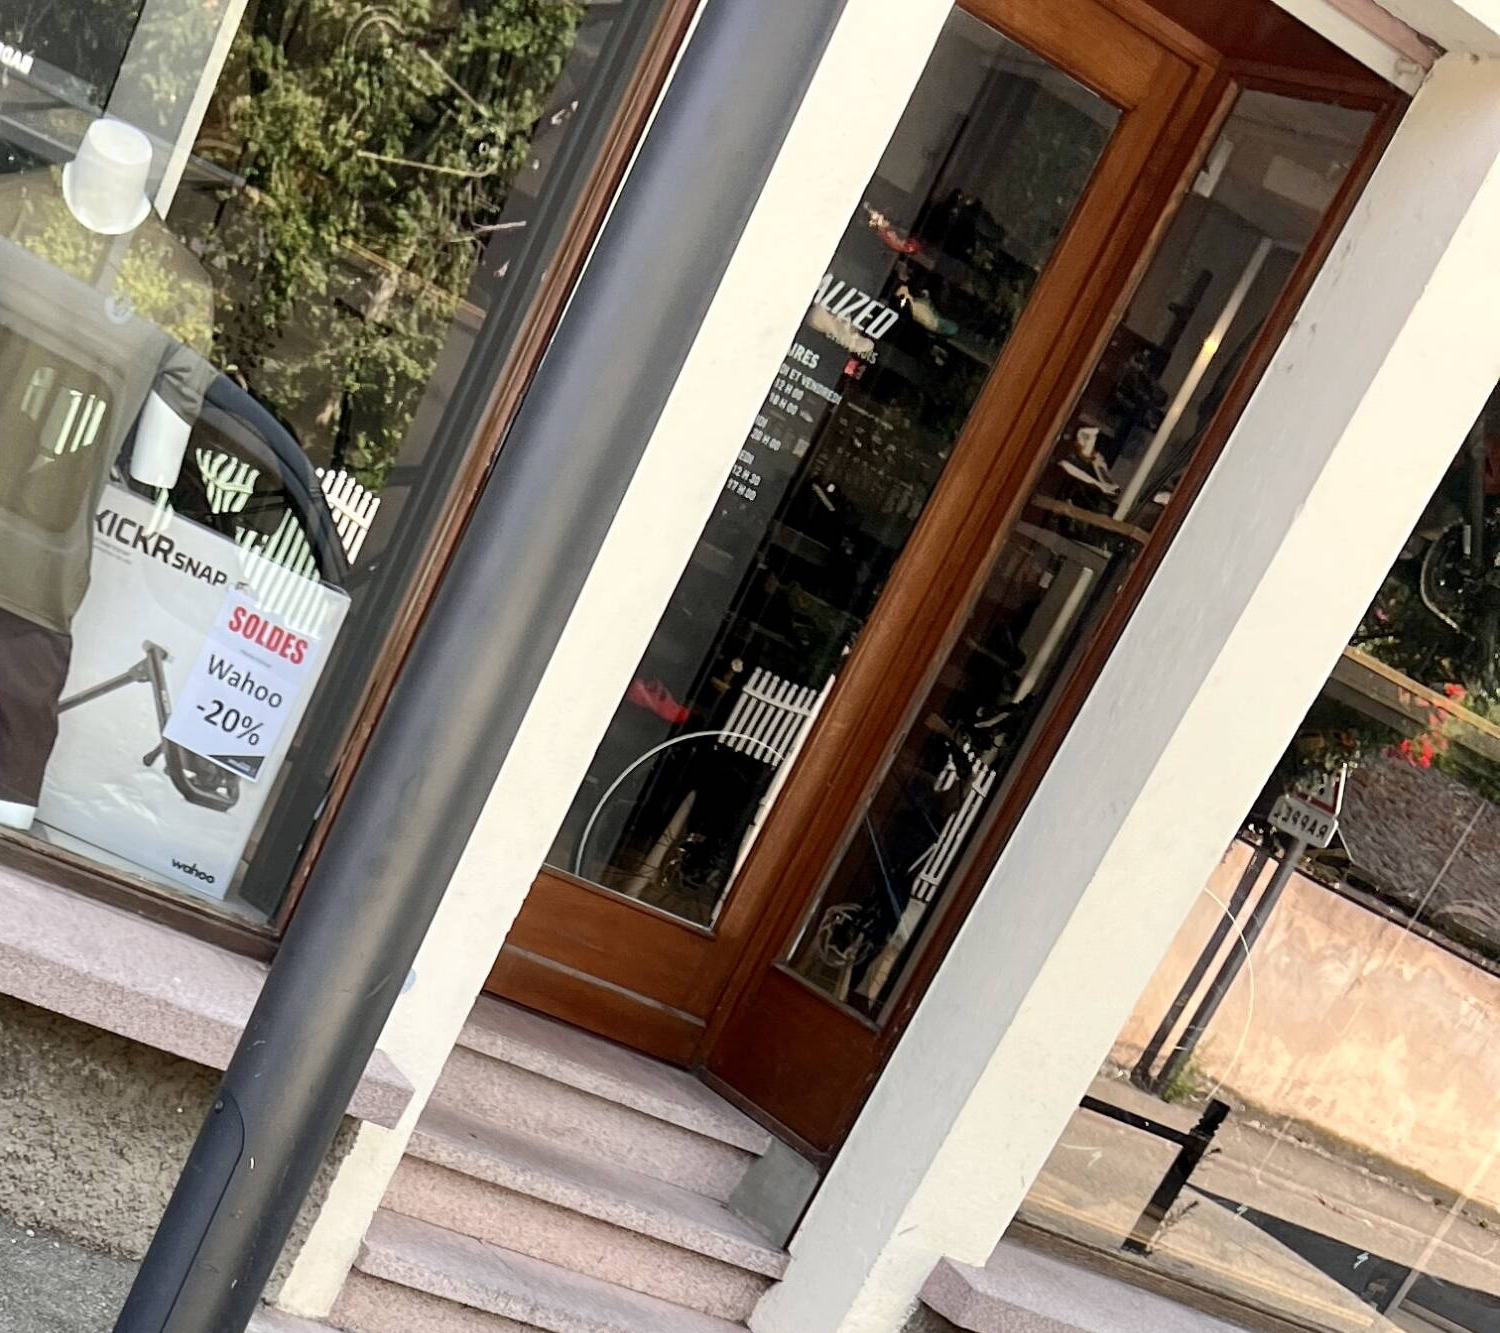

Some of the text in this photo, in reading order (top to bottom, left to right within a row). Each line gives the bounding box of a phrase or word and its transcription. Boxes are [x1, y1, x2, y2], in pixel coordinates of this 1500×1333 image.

[172, 552, 228, 586] SNAP
[228, 606, 309, 665] SOLDES
[207, 653, 283, 708] Wahoo
[196, 699, 264, 746] -20%
[171, 858, 215, 884] wahoo
